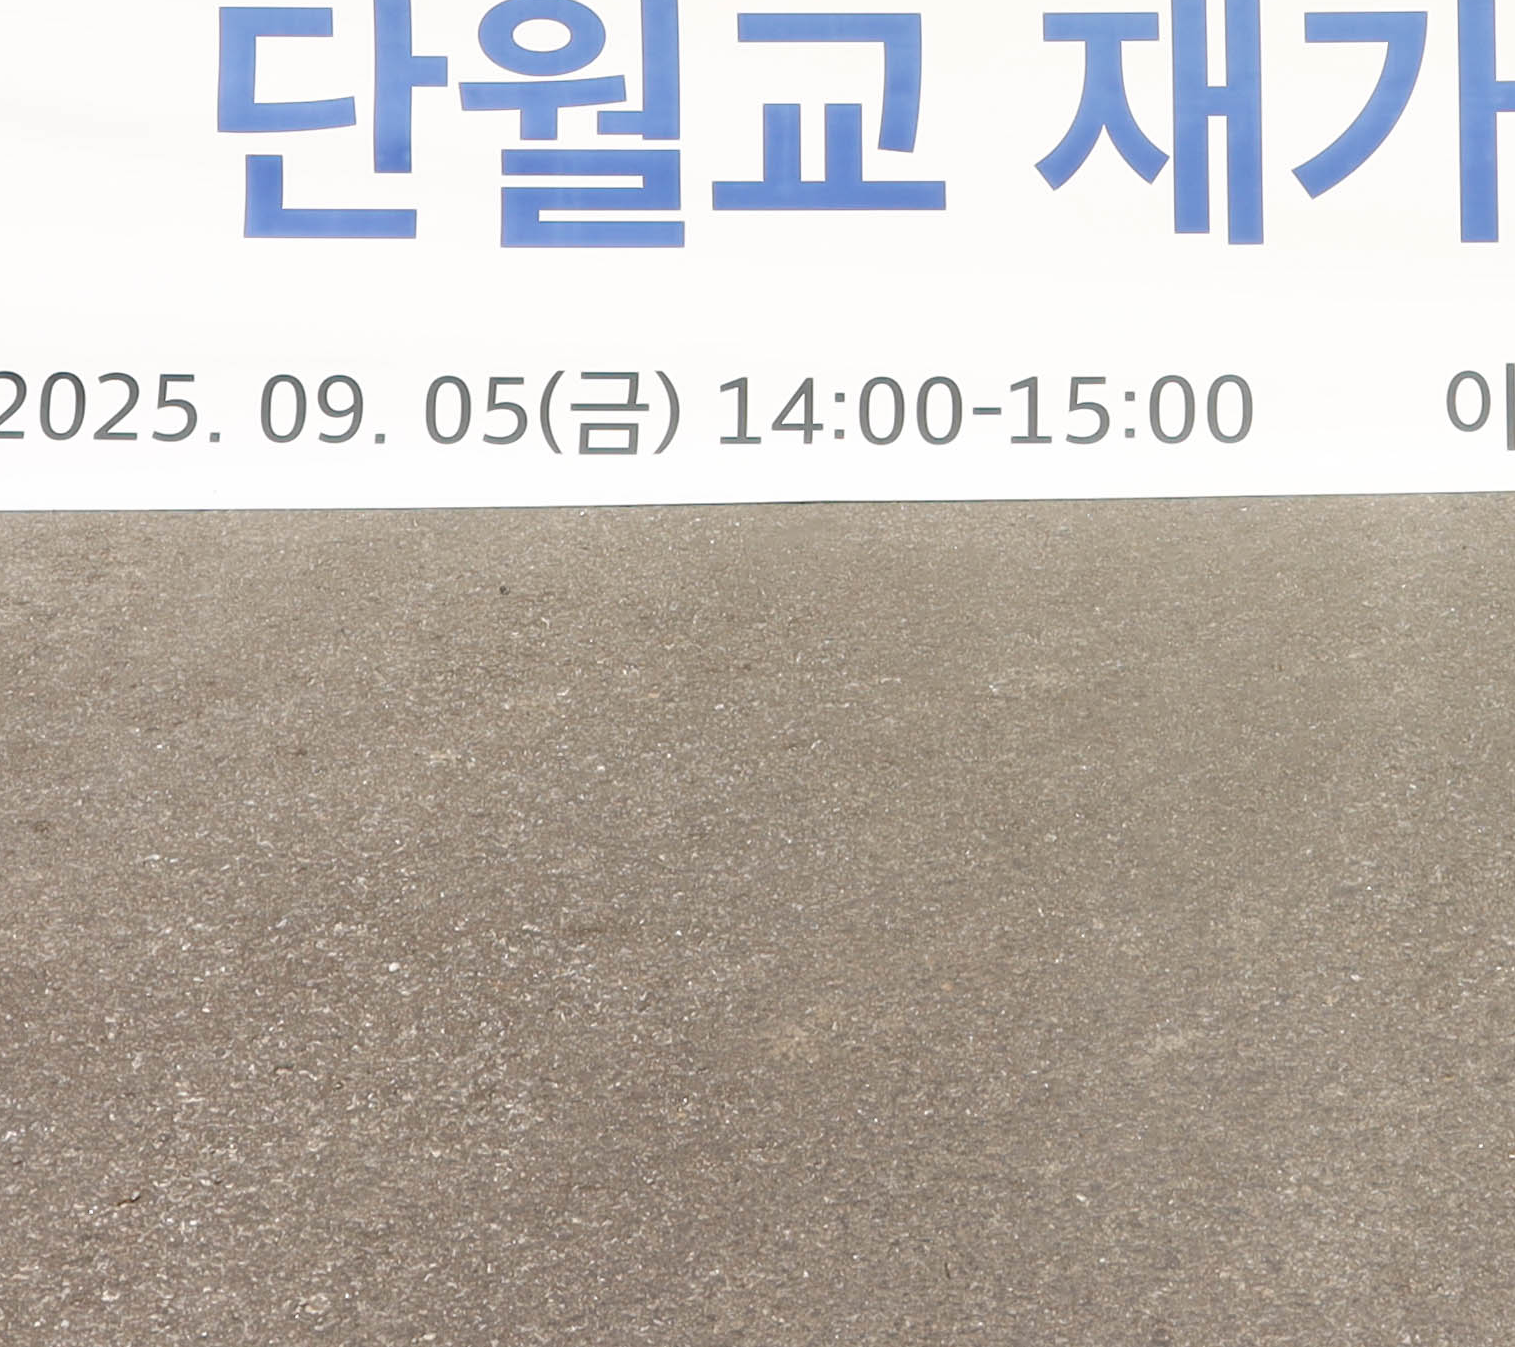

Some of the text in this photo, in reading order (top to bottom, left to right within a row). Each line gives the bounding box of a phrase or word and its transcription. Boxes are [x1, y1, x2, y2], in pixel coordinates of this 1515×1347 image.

[261, 374, 385, 444] 09.
[426, 371, 680, 455] 05(금)
[720, 375, 1253, 445] 14:00-15:00
